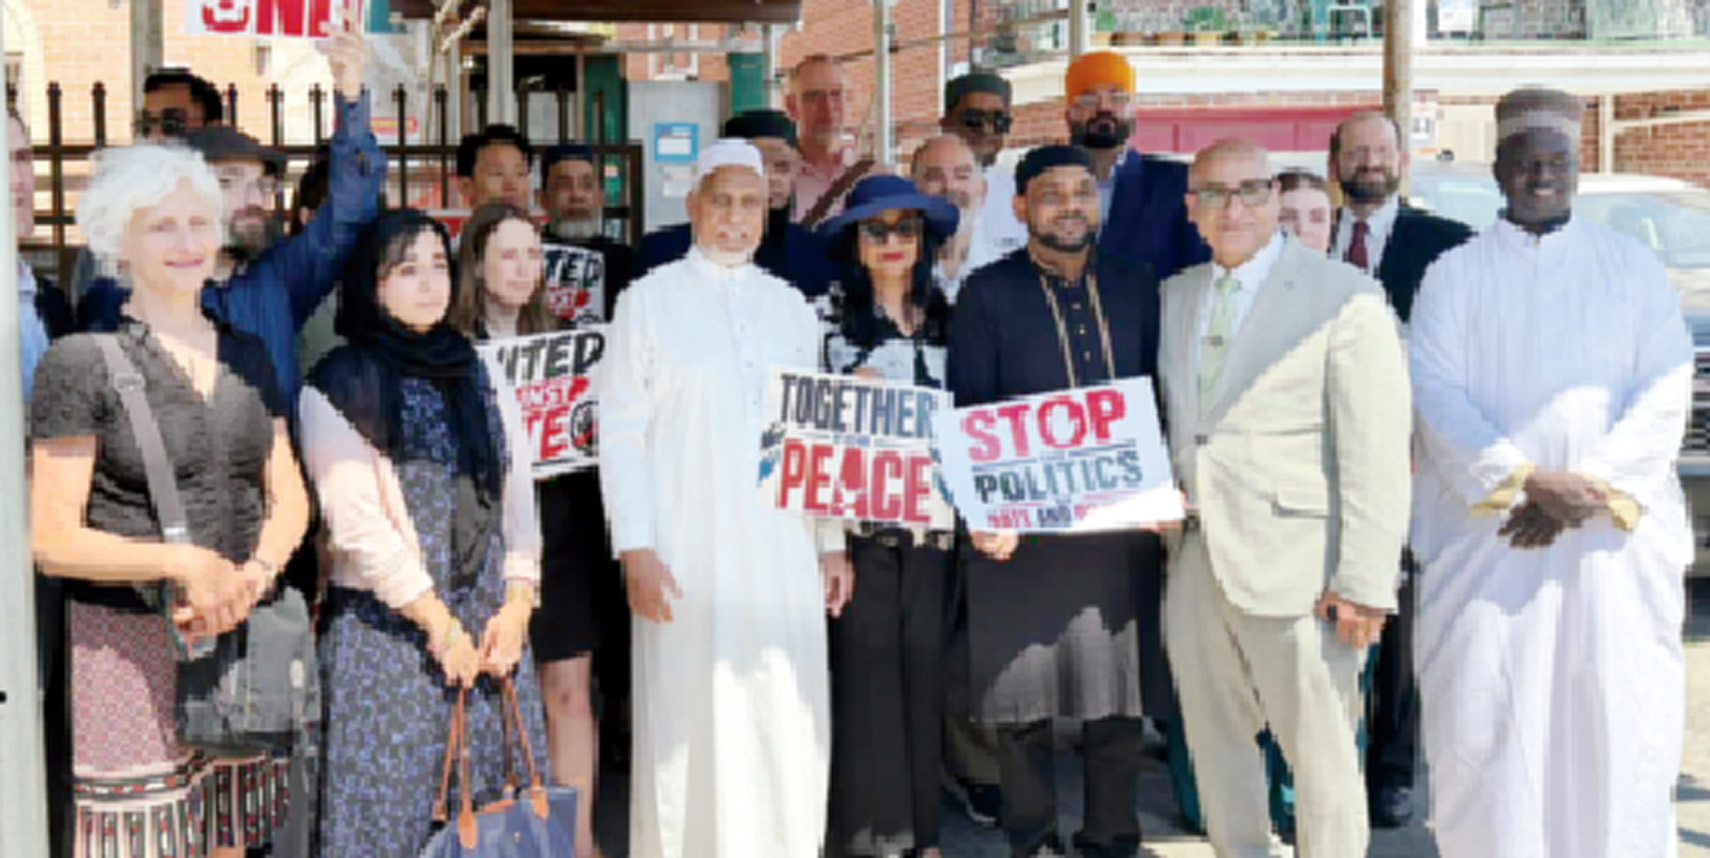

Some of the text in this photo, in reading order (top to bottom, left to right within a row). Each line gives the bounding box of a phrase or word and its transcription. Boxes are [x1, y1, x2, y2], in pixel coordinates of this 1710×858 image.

[781, 374, 935, 438] TOGETHER
[962, 389, 1126, 461] STOP
[777, 438, 933, 522] PEACE
[974, 452, 1143, 503] POLITICS
